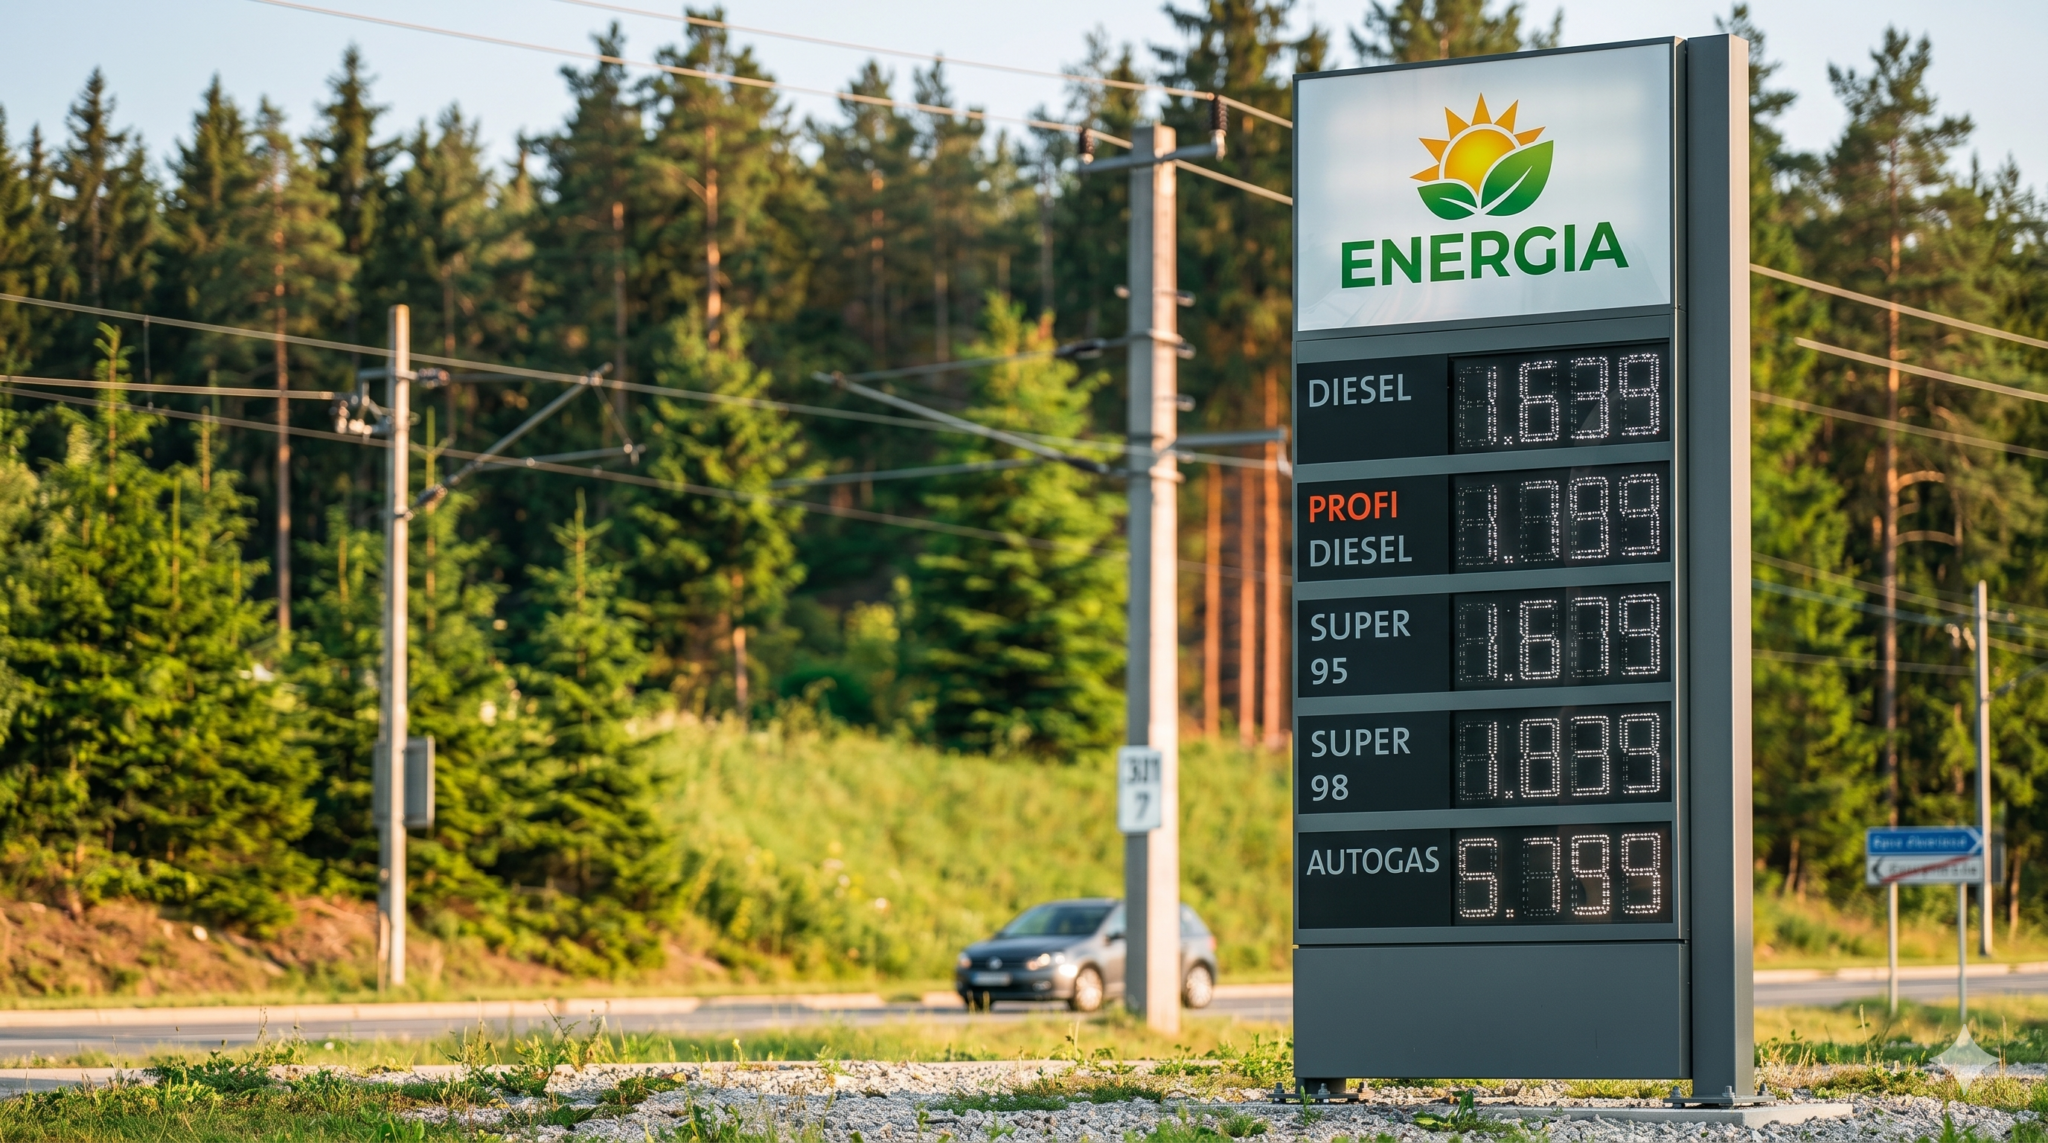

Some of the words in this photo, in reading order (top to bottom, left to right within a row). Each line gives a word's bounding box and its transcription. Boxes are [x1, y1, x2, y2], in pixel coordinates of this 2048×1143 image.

[1341, 221, 1630, 289] ENERGIA
[1309, 373, 1412, 408] DIESEL
[1486, 352, 1661, 447] 1.639
[1309, 490, 1398, 523] PROFI
[1486, 472, 1661, 564] 1.799
[1310, 534, 1413, 567] DIESEL
[1310, 609, 1411, 642] SUPER
[1487, 592, 1661, 681] 1.679
[1310, 657, 1348, 685] 95
[1311, 727, 1411, 758] SUPER
[1488, 712, 1661, 799] 1.839
[1311, 773, 1349, 802] 98
[1306, 846, 1440, 876] AUTOGAS
[1458, 832, 1661, 919] 5.799
